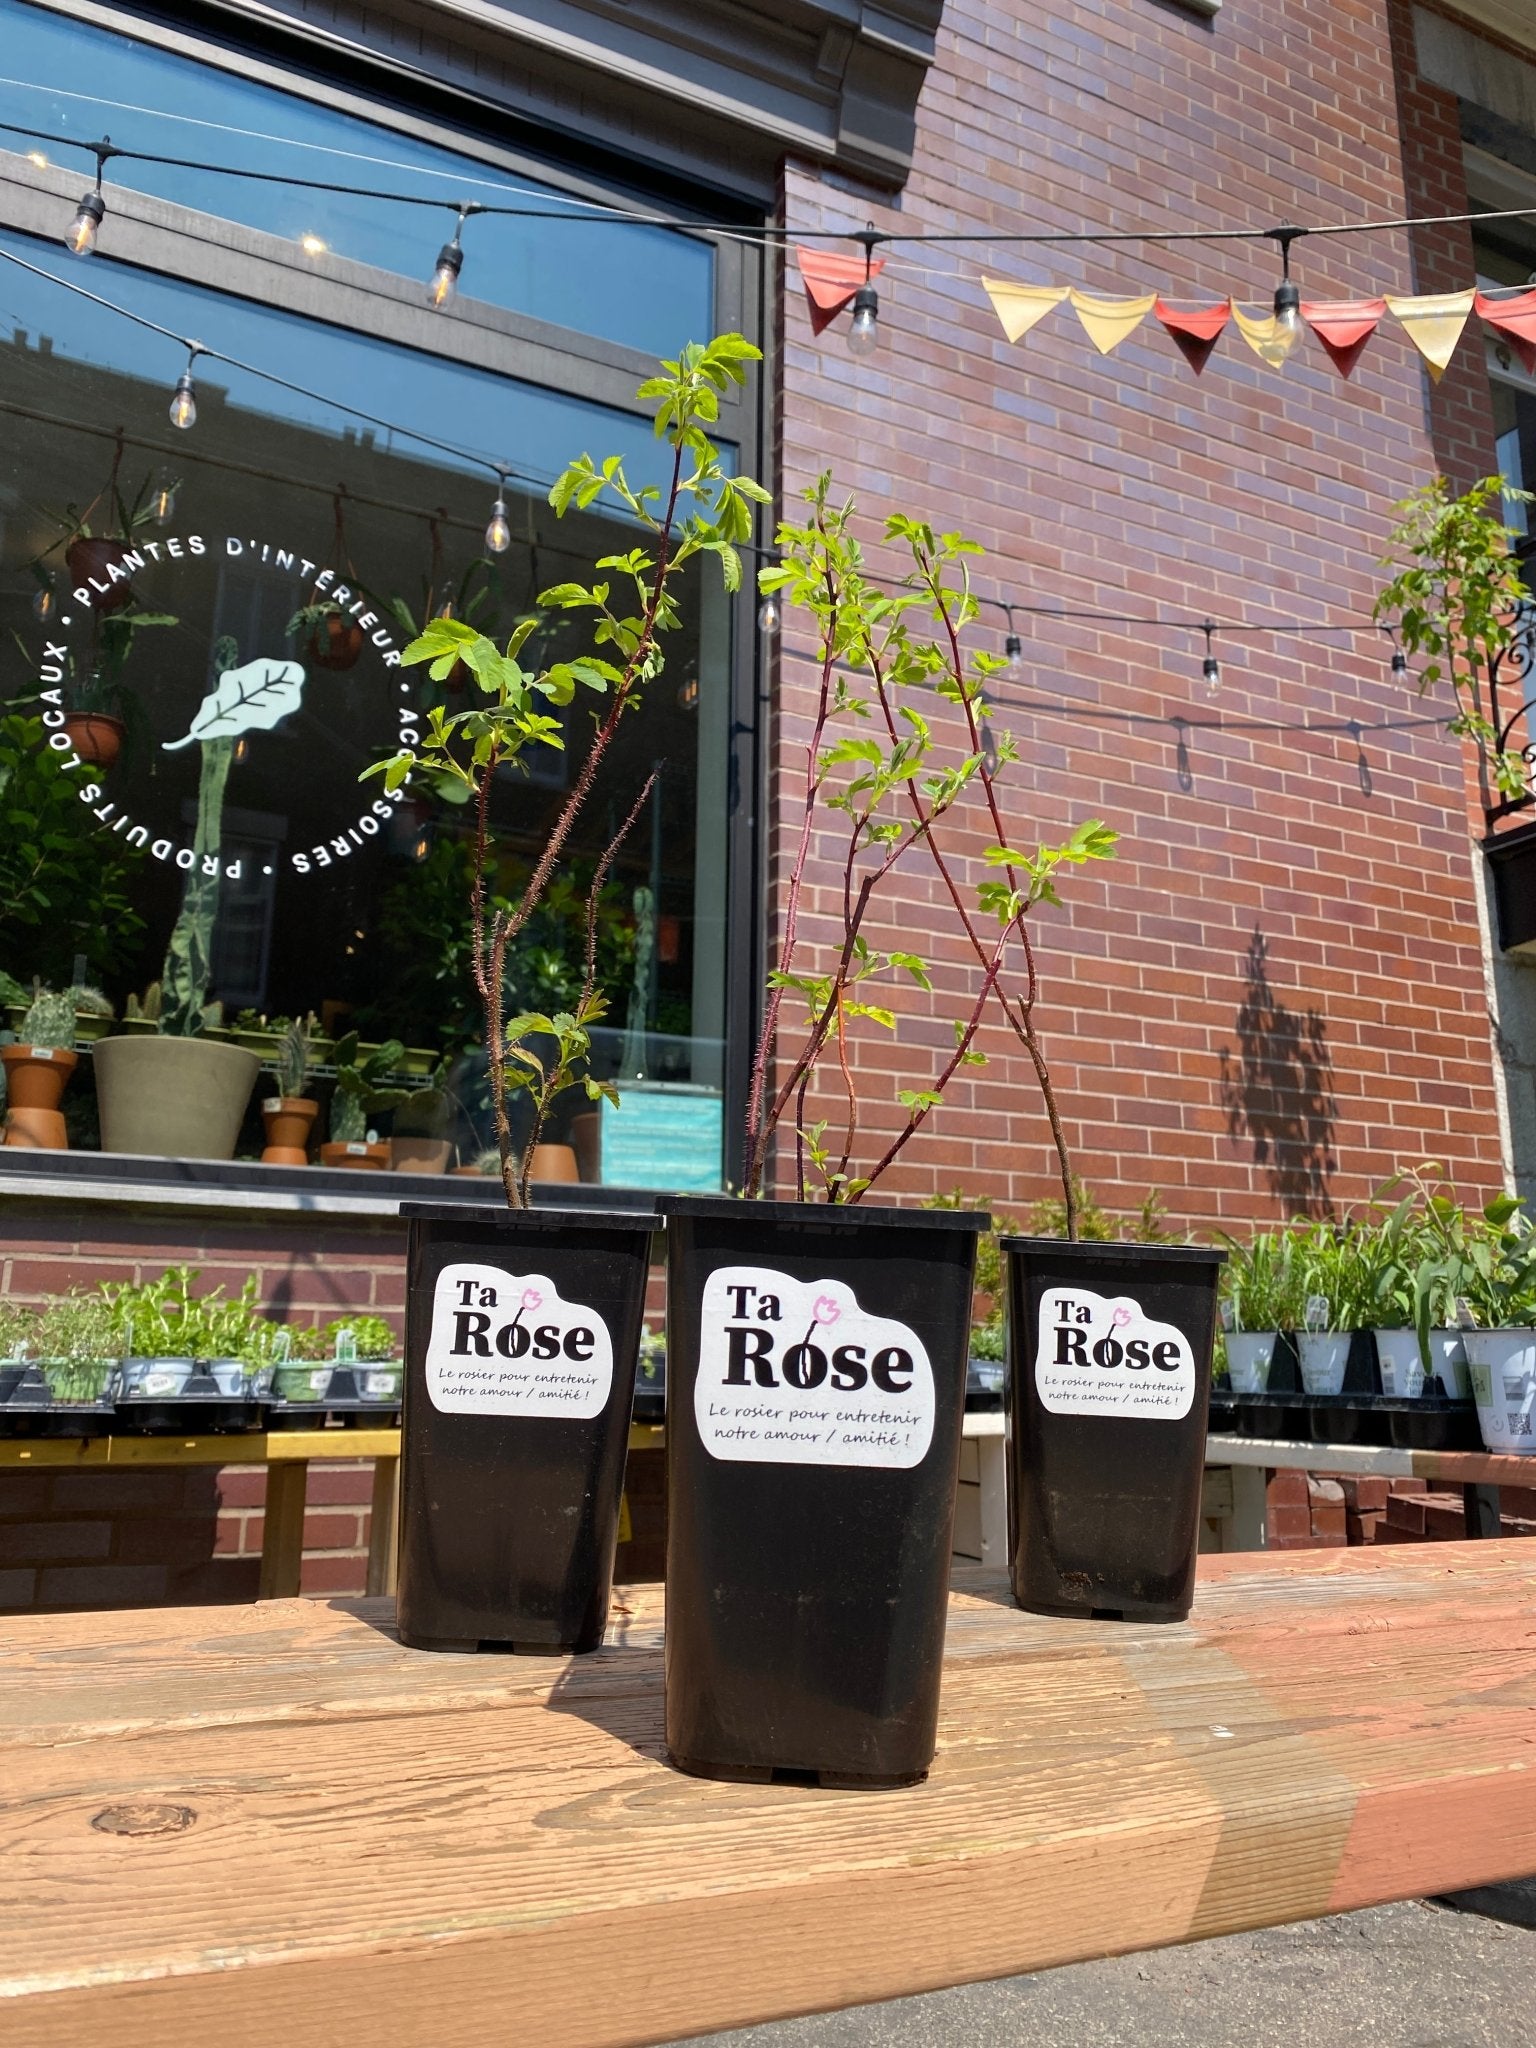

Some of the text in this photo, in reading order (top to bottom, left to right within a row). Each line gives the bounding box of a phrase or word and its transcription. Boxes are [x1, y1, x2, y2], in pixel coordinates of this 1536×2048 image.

[73, 535, 401, 669] PLANTES D'INTÉRIEUR
[40, 641, 241, 880] PRODUITS LOCAUX
[456, 1280, 499, 1308] Ta
[726, 1285, 783, 1321] Ta
[1054, 1300, 1093, 1324] Ta
[449, 1311, 595, 1362] Rose
[1053, 1326, 1181, 1372] Rose
[721, 1326, 914, 1393] Rose
[439, 1368, 599, 1385] Le rosier pour entretenir
[1045, 1376, 1187, 1392] Le rosier pour entretenir
[442, 1386, 477, 1396] notre
[480, 1388, 523, 1399] amour
[538, 1389, 582, 1400] amitié
[1048, 1392, 1079, 1400] notre
[1081, 1394, 1119, 1403] amour
[709, 1403, 922, 1425] Le rosier pour entretenir
[715, 1427, 760, 1439] notre
[764, 1430, 821, 1442] amour
[826, 1430, 836, 1442] /
[842, 1432, 900, 1446] amitié
